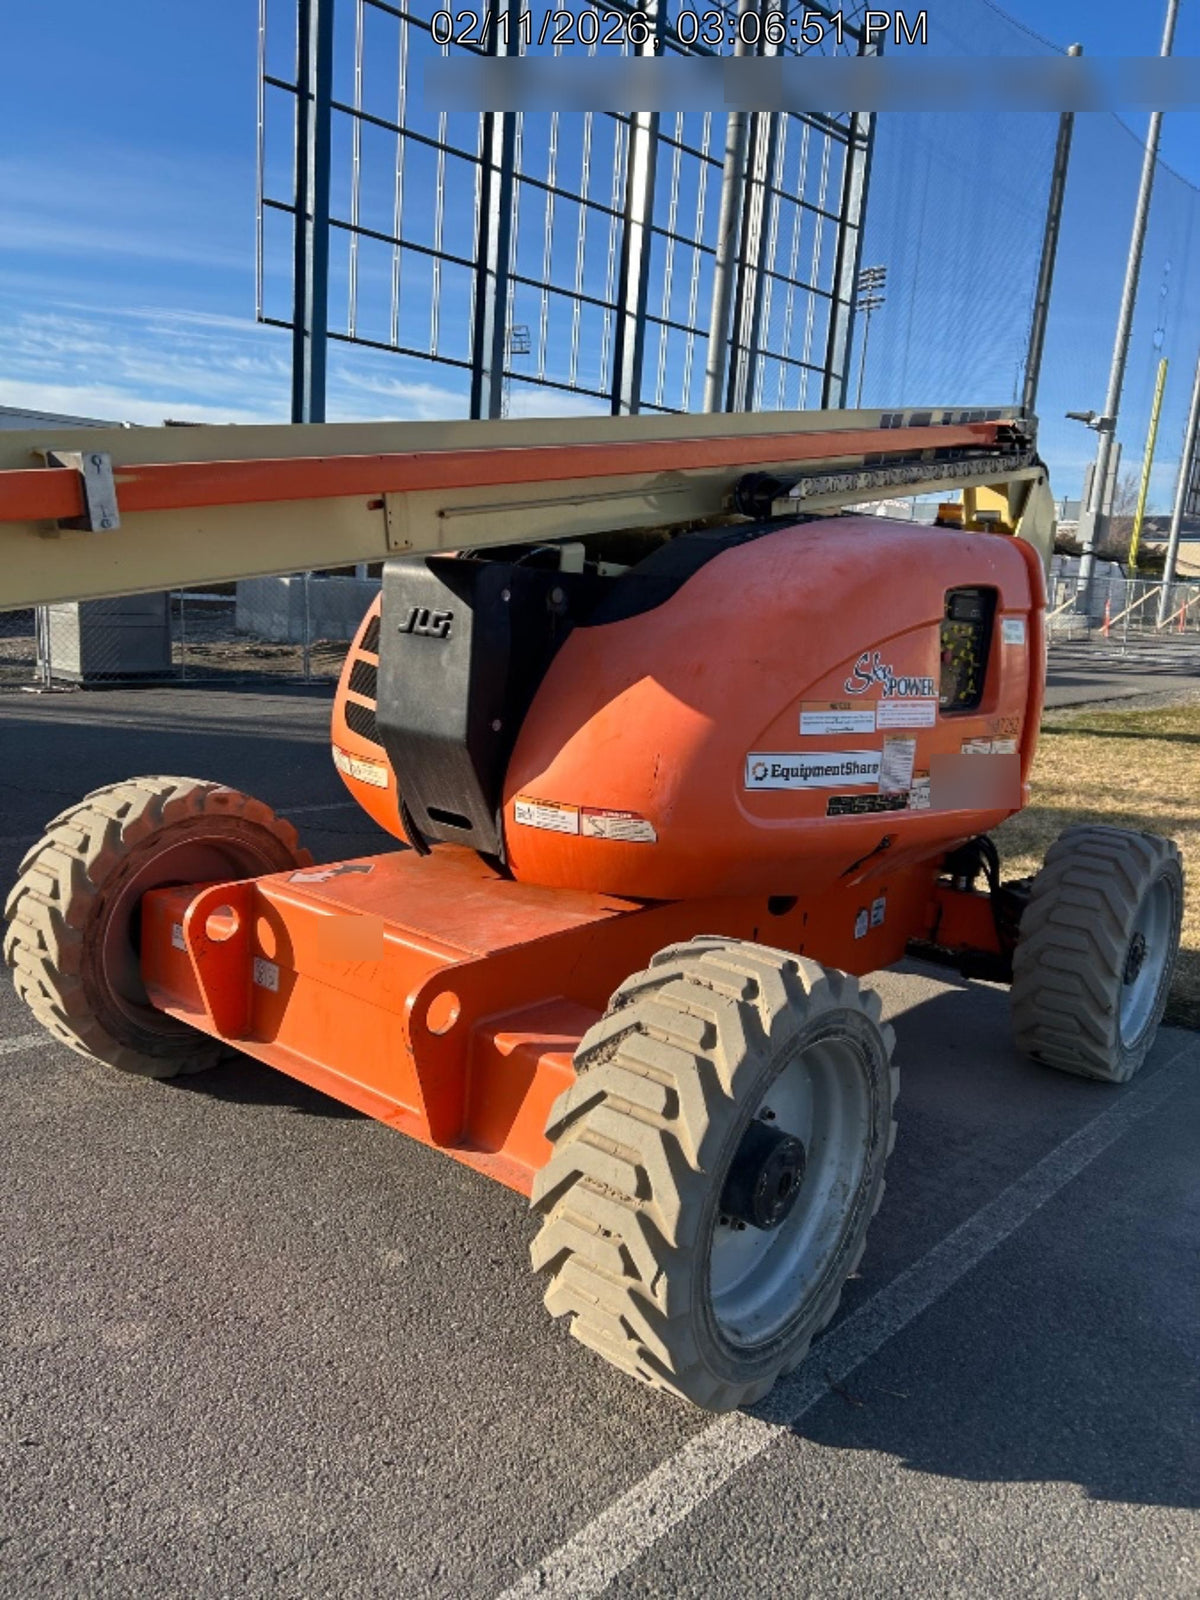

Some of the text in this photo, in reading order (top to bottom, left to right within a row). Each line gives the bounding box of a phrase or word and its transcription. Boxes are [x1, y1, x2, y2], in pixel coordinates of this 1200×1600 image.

[398, 606, 454, 640] JLG
[887, 677, 939, 697] POWER
[771, 761, 879, 781] EquipmentShare
